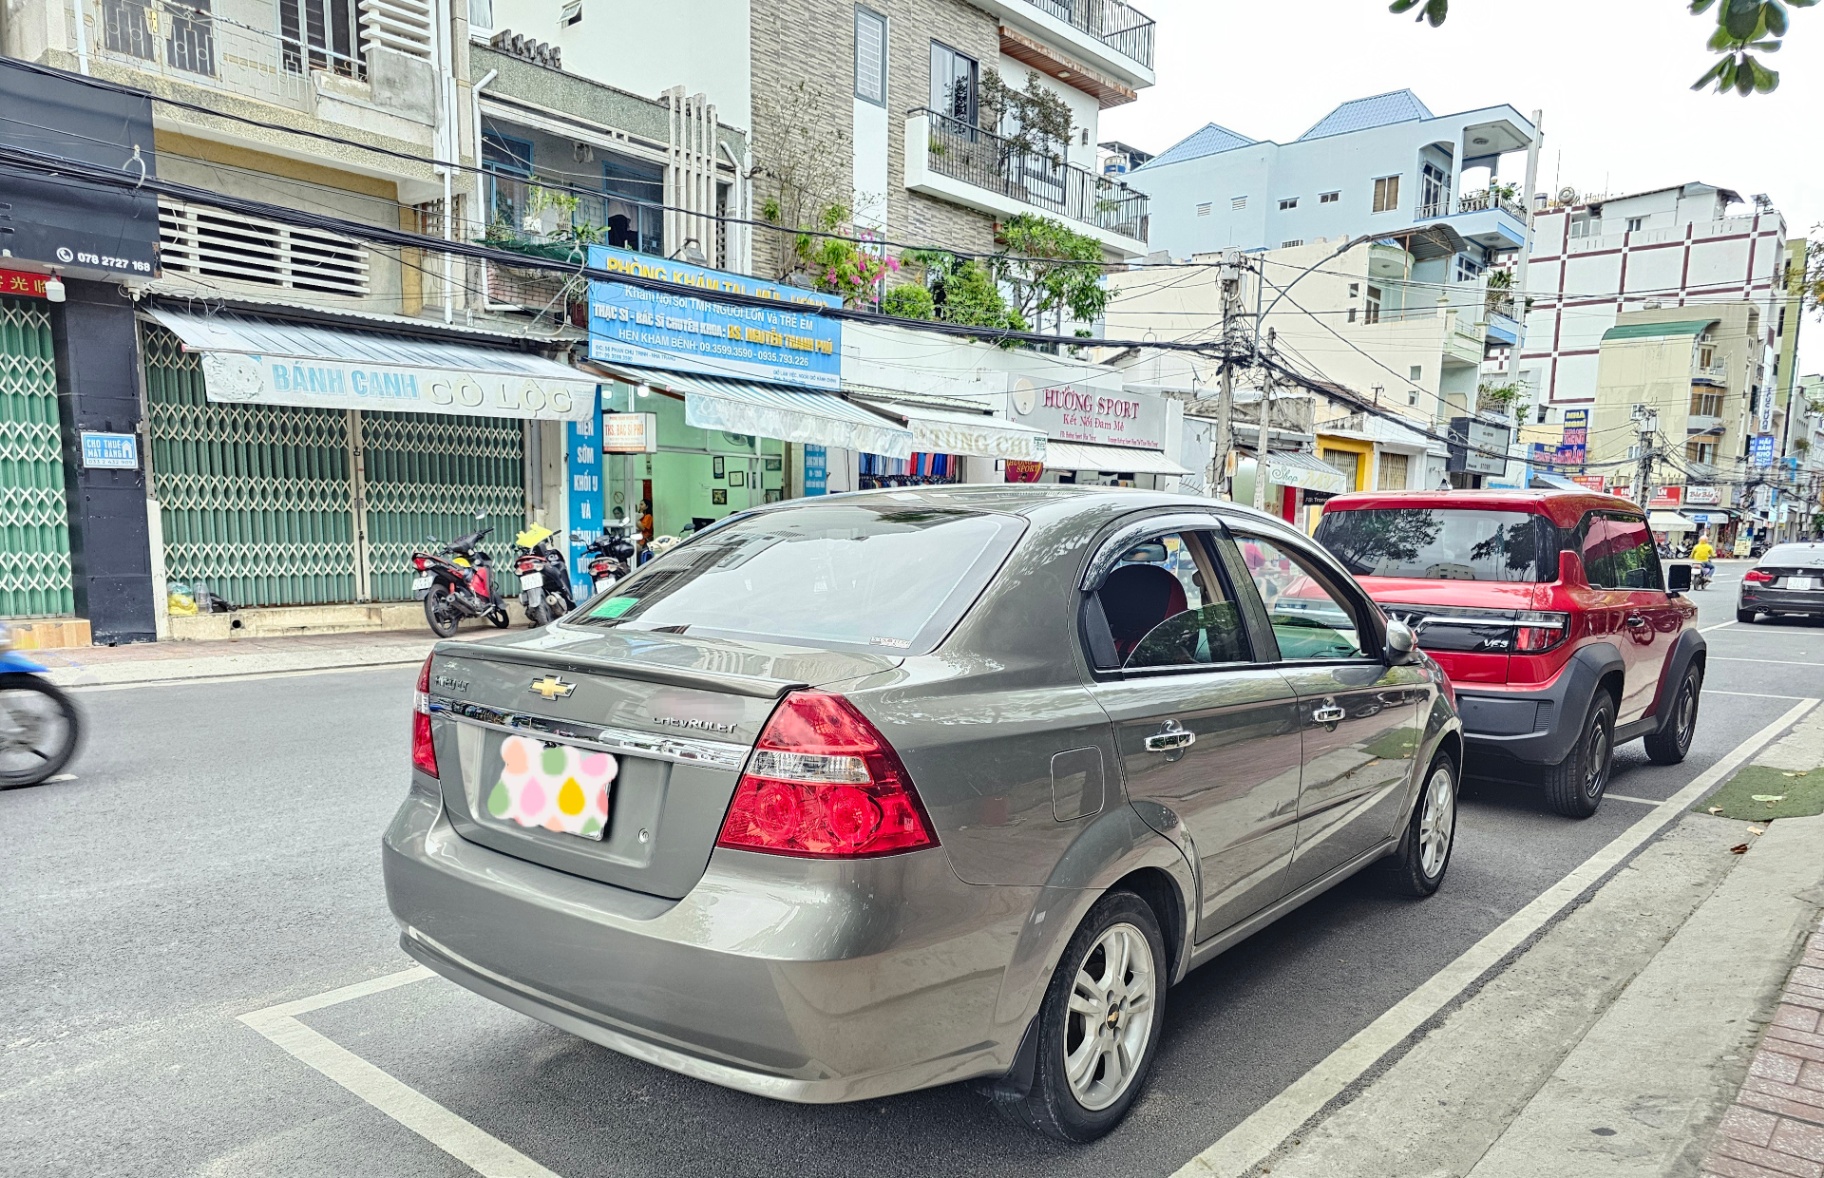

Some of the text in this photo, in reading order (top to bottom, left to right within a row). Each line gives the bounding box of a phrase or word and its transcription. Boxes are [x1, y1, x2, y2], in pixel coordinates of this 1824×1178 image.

[77, 252, 151, 272] 078 2727 168
[593, 302, 618, 322] THẠC
[635, 308, 654, 327] BÁC
[666, 315, 699, 334] CHUYÊN
[745, 326, 783, 347] NGUYỄN
[815, 337, 833, 355] PHÚ
[780, 312, 798, 328] TRẺ
[800, 318, 813, 331] EM
[618, 328, 639, 342] HẸN
[641, 331, 670, 347] KHÁM
[699, 341, 753, 359] 09.3599.3590
[757, 350, 809, 367] 0935.793.226
[271, 360, 347, 396] BÁNH
[351, 369, 420, 400] CANH
[1097, 396, 1140, 419] SPORT
[1063, 412, 1078, 426] Kết
[1094, 417, 1112, 430] Đam
[86, 438, 102, 449] CHO
[930, 424, 990, 454] TÙNG
[995, 435, 1031, 457] CHI
[577, 443, 595, 464] SỚM
[574, 468, 592, 492] KHỐI
[1271, 463, 1299, 485] Shop
[581, 499, 592, 519] VÀ
